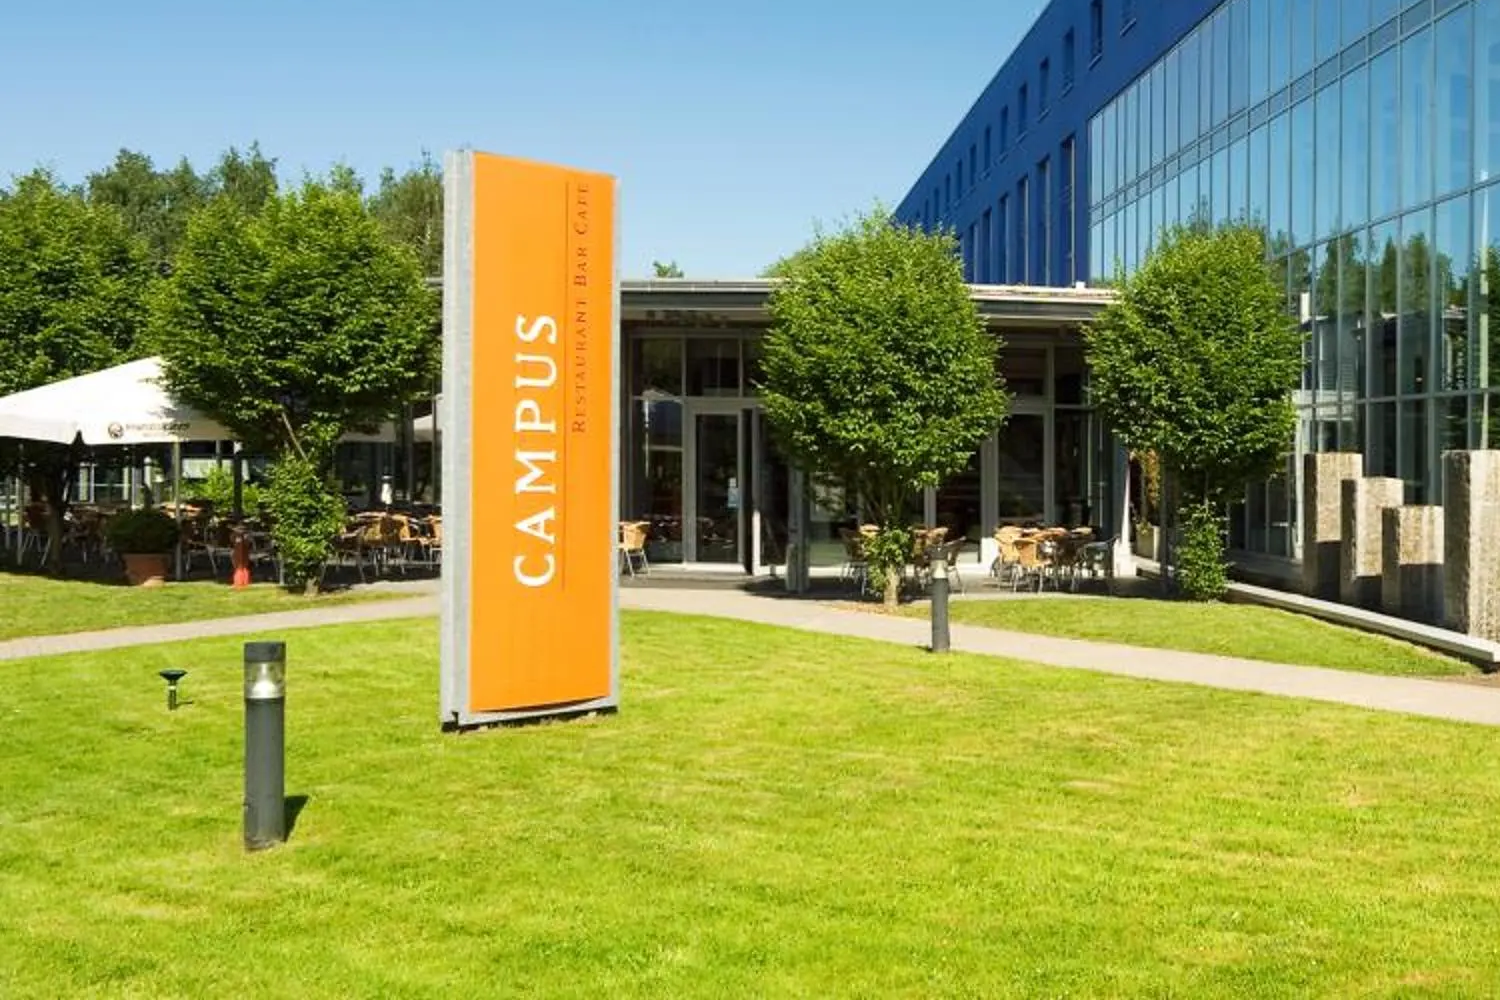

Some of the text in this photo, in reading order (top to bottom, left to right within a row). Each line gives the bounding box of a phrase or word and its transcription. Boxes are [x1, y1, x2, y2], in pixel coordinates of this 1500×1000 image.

[573, 246, 588, 287] BAR
[571, 300, 588, 434] RESTAURANT
[513, 314, 558, 588] CAMPUS
